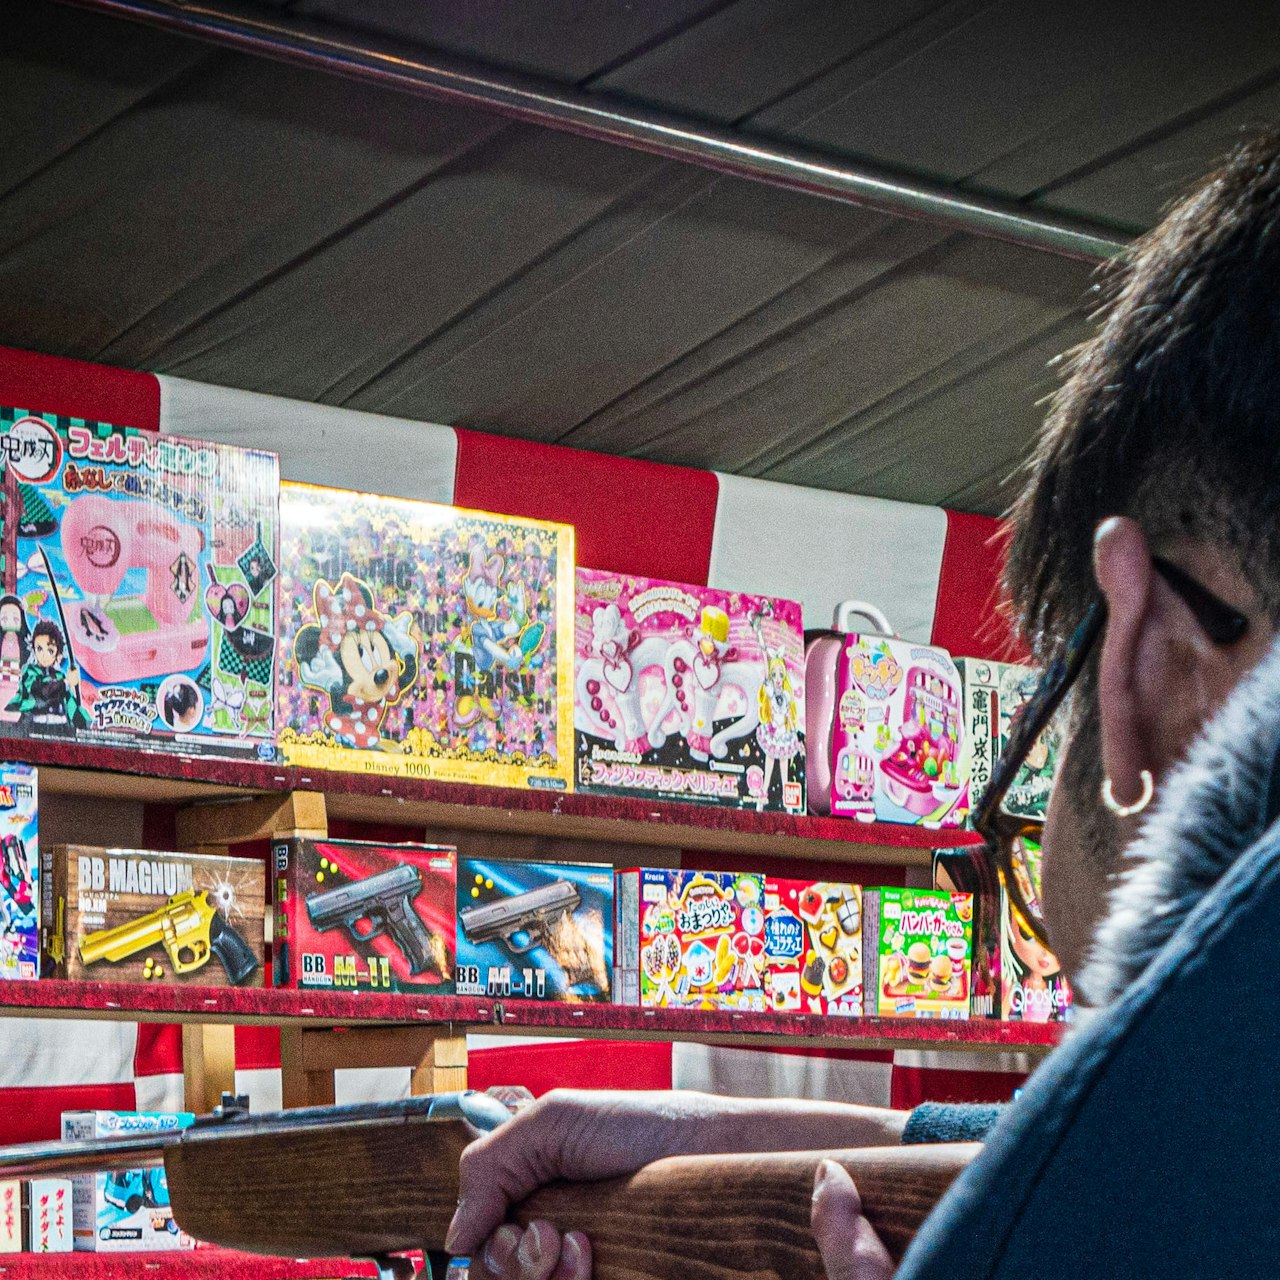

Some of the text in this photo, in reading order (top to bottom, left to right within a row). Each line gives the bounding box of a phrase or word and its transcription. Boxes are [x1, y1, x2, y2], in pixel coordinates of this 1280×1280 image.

[364, 761, 400, 776] Disney
[405, 763, 431, 778] 1000
[277, 845, 289, 870] BB
[78, 856, 193, 896] BB MAGNUM
[644, 872, 665, 881] Kracie
[900, 910, 965, 938] ハンバーガーやさん
[303, 954, 390, 988] BB M-11
[457, 965, 546, 997] BB M-11
